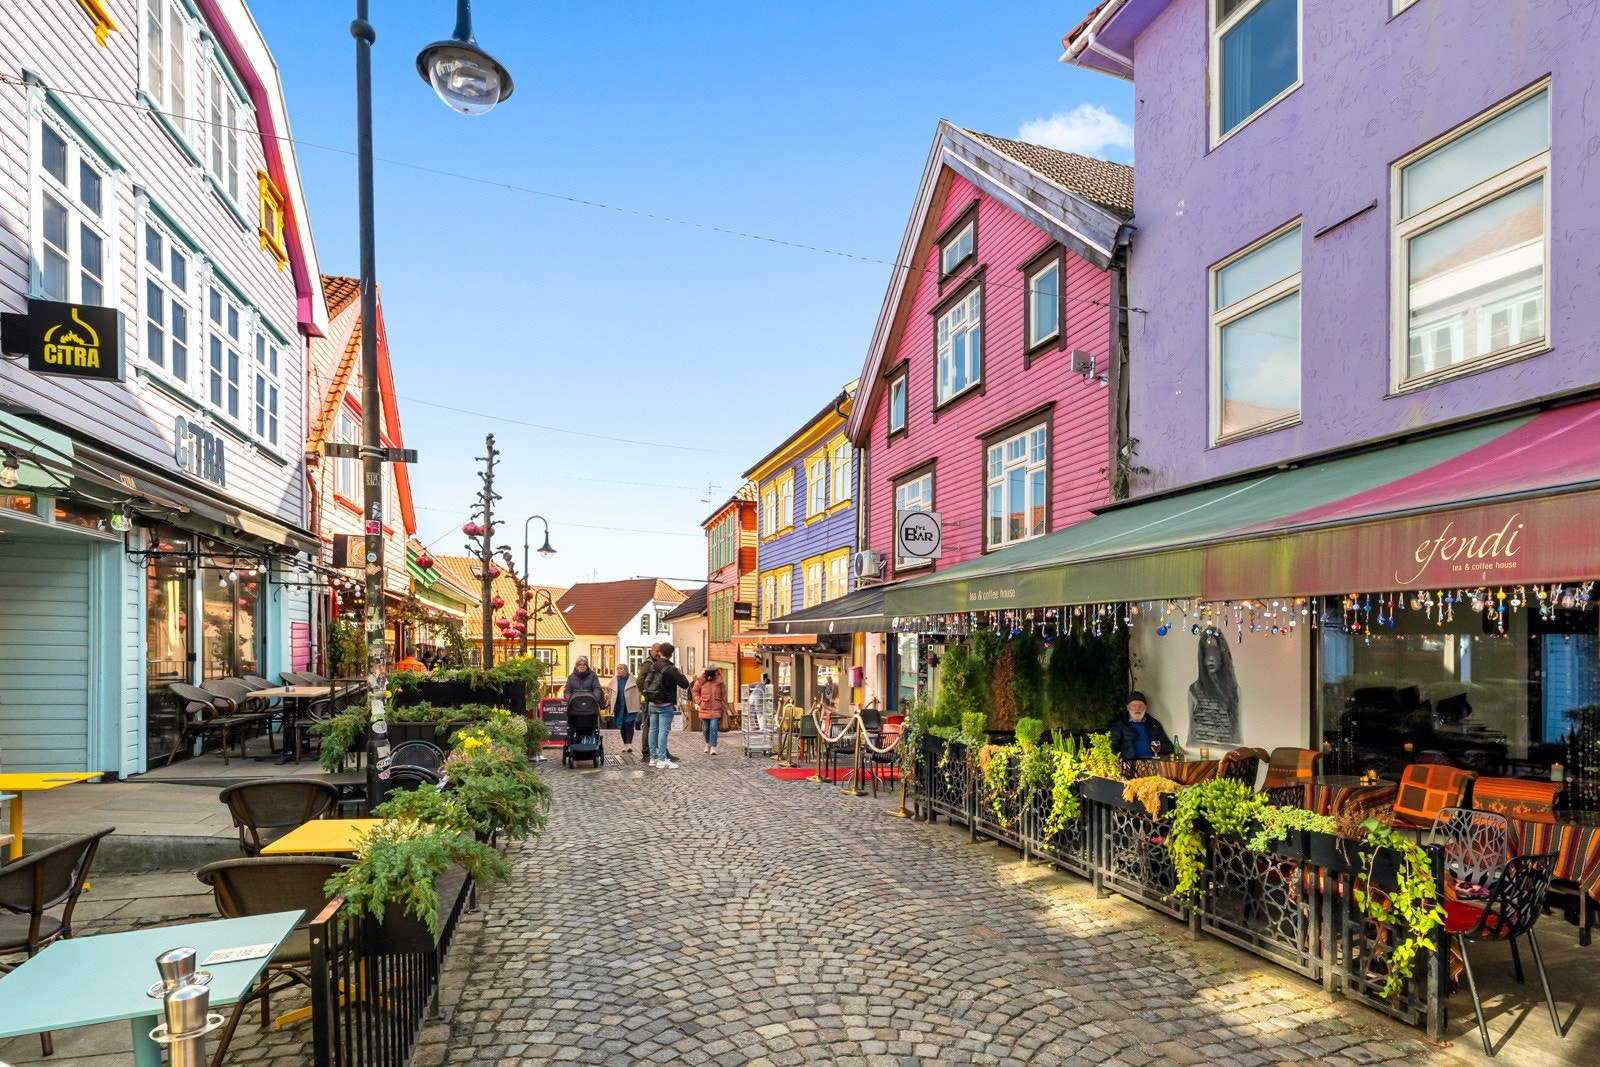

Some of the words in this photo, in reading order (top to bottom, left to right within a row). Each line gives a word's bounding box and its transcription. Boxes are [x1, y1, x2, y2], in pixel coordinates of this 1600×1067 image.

[1395, 512, 1524, 585] efendi
[1452, 564, 1462, 572] tea
[1464, 563, 1470, 571] &
[1472, 562, 1493, 571] coffee
[1495, 561, 1517, 569] house
[983, 589, 999, 601] coffee
[1000, 588, 1016, 599] house
